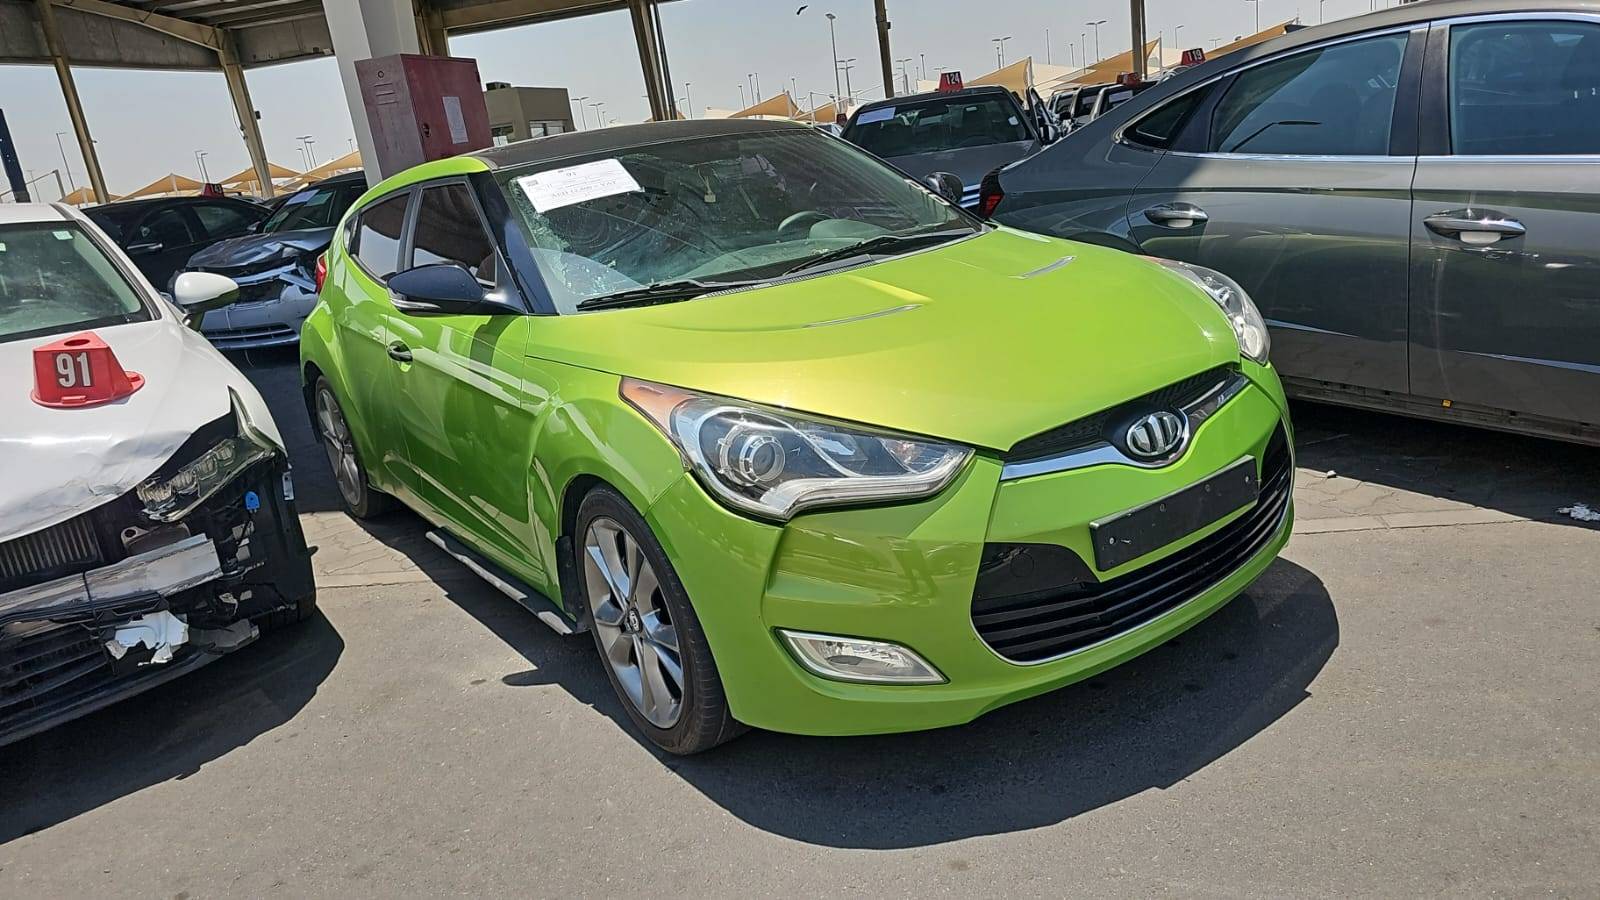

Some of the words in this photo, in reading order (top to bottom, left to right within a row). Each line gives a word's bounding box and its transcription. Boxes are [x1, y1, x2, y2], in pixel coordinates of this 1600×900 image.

[1188, 49, 1203, 61] 119
[945, 72, 960, 85] 124
[56, 352, 91, 387] 91
